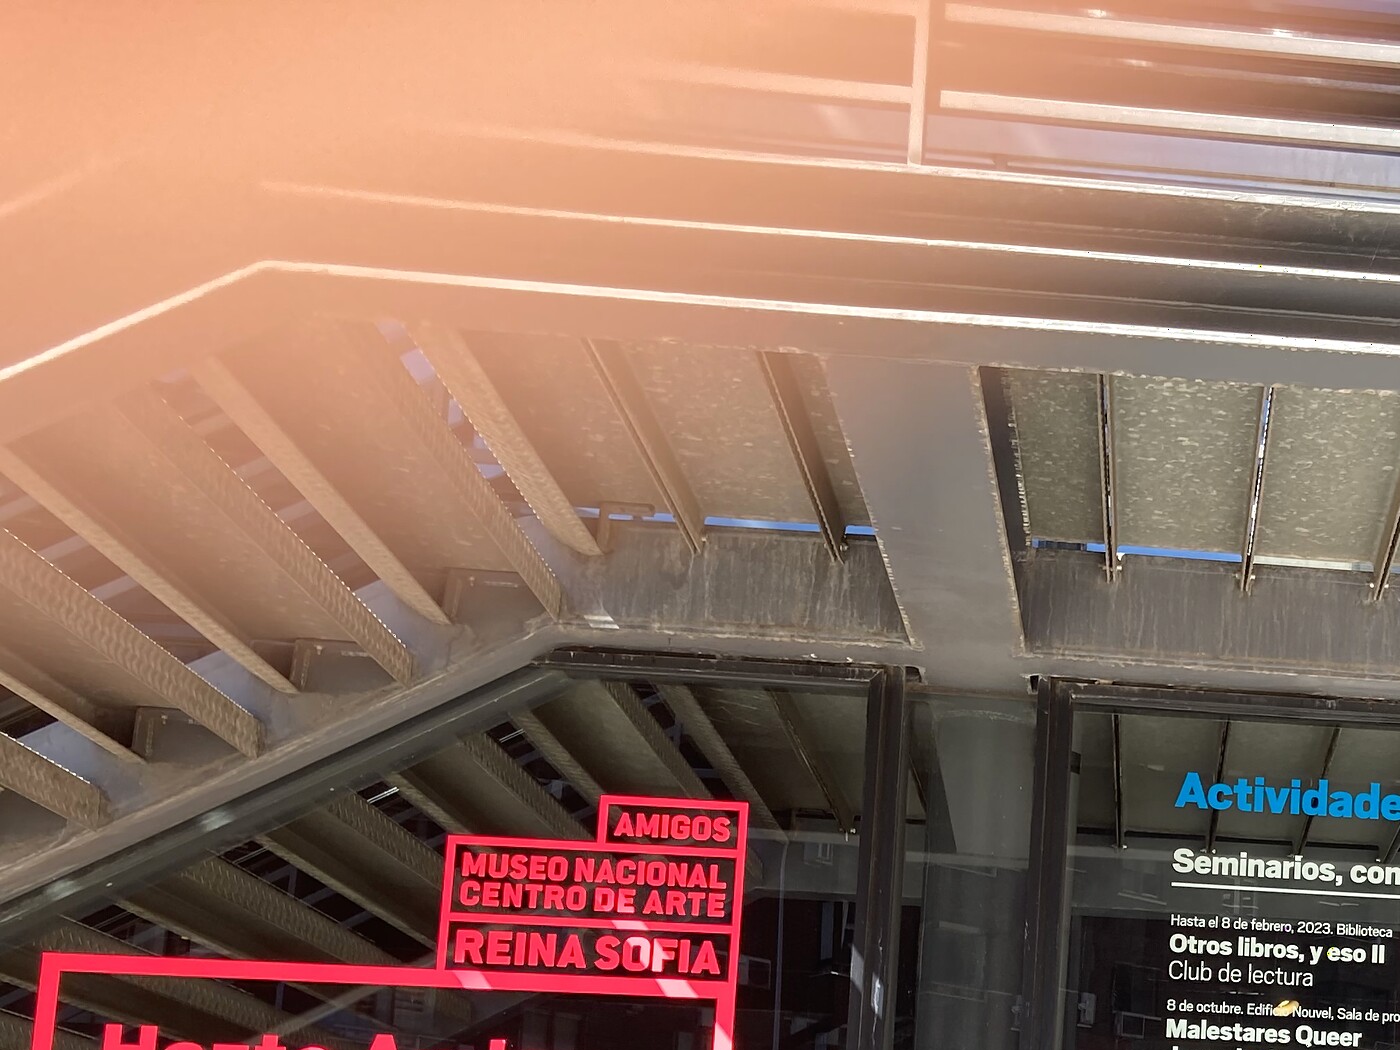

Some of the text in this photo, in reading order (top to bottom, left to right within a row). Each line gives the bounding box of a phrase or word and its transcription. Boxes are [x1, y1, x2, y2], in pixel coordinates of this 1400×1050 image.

[613, 812, 731, 842] AMIGOS
[461, 852, 727, 890] MUSEO NACIONAL
[1173, 848, 1342, 885] Seminarios,
[459, 880, 726, 918] CENTRO DE ARTE
[1171, 912, 1392, 937] Hasta el 8 de febrero, 2023. Biblioteca
[454, 929, 721, 975] REINA SOFIA
[1170, 933, 1385, 965] Otros libros, y eso II
[1169, 960, 1314, 987] Club de lectura
[1167, 997, 1176, 1012] 8
[1179, 997, 1194, 1013] de
[1197, 999, 1244, 1016] octubre.
[1293, 1003, 1334, 1022] Nouvel,
[1337, 1006, 1362, 1022] Sala
[1365, 1007, 1380, 1023] de
[1166, 1018, 1362, 1047] Malestares Queer
